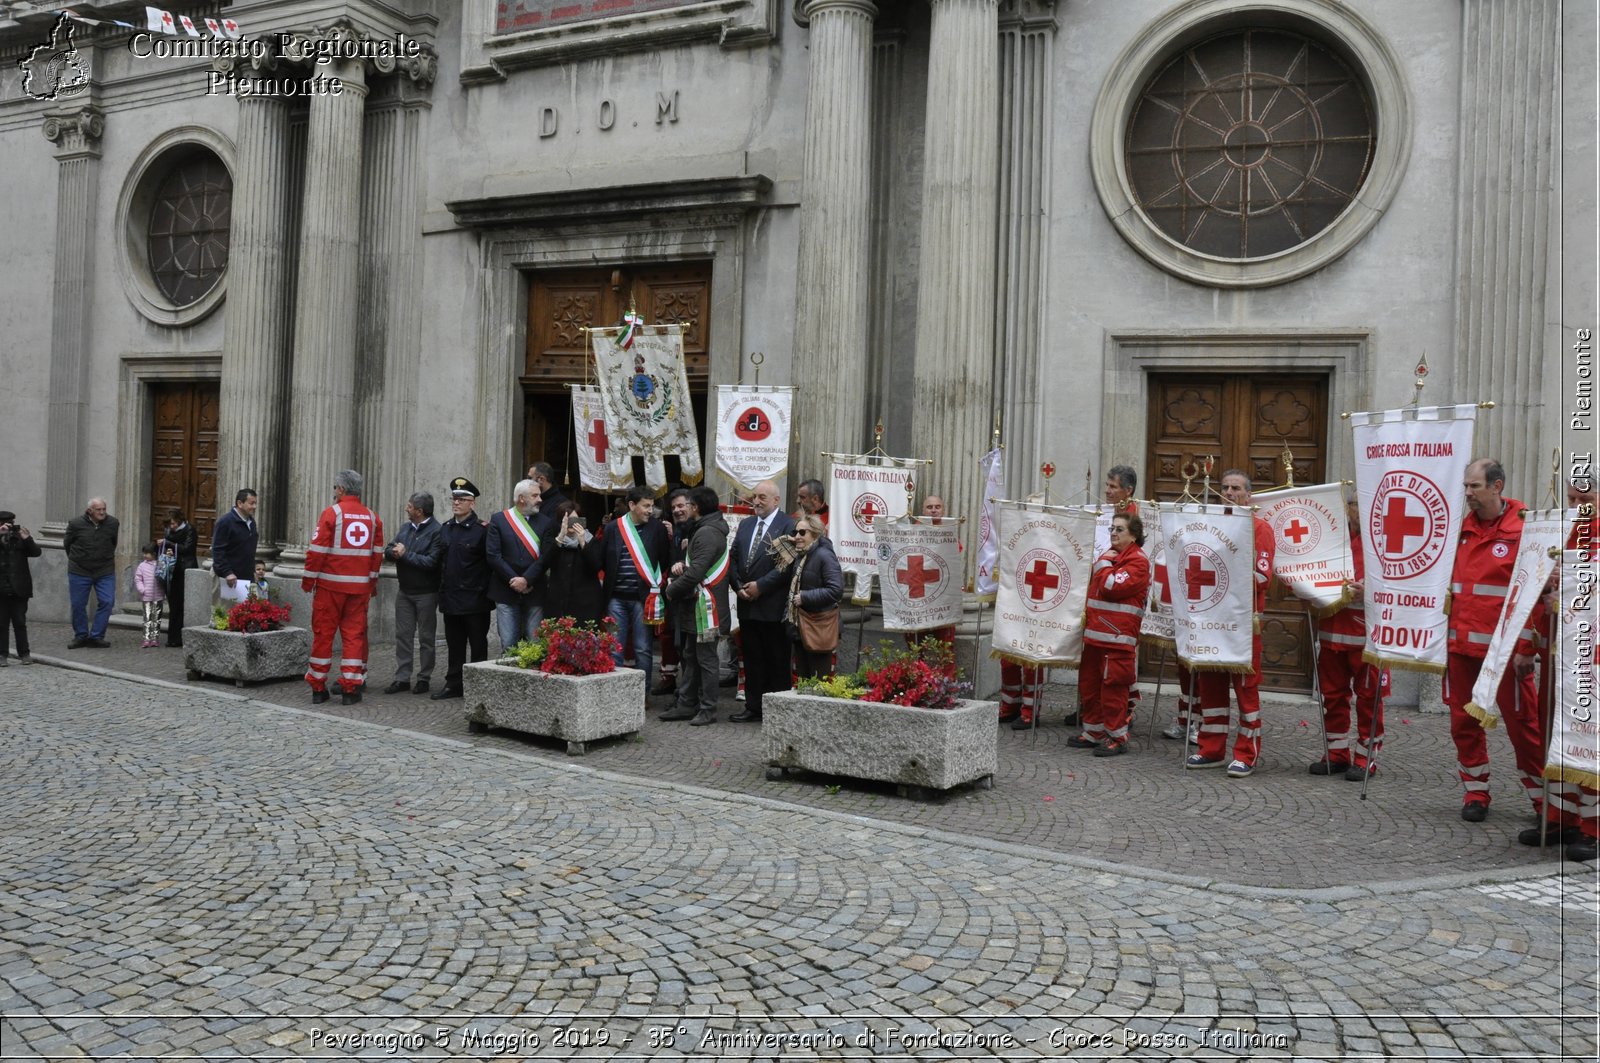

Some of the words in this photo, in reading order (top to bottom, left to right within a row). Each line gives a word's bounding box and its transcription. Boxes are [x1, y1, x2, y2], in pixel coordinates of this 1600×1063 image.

[1366, 445, 1385, 460] CROCE
[1385, 443, 1411, 457] ROSSA
[1413, 443, 1453, 457] ITALIANA
[834, 469, 856, 480] CROCE
[857, 470, 878, 482] ROSSA
[879, 472, 908, 484] ITALIAN
[1273, 498, 1302, 512] ROSSA
[1304, 498, 1338, 531] ITALIANA
[1422, 487, 1446, 538] GINEVRA
[1028, 520, 1057, 530] ROSSA
[1058, 527, 1084, 561] ITALIANA
[1185, 522, 1208, 533] ROSSA
[1210, 525, 1239, 555] ITALIANA
[1275, 561, 1315, 575] GRUPPO
[1317, 560, 1327, 569] DI
[1407, 552, 1433, 573] 1864
[1305, 569, 1352, 581] MONDOVI'
[1397, 594, 1437, 608] LOCALE
[901, 613, 944, 625] MORETTA
[1002, 612, 1038, 626] COMITATO
[1039, 620, 1072, 632] LOCALE
[1382, 608, 1393, 621] di
[1028, 630, 1037, 638] DI
[1201, 622, 1238, 632] LOCALE
[1189, 633, 1197, 641] DI
[1011, 638, 1054, 656] BUSCA
